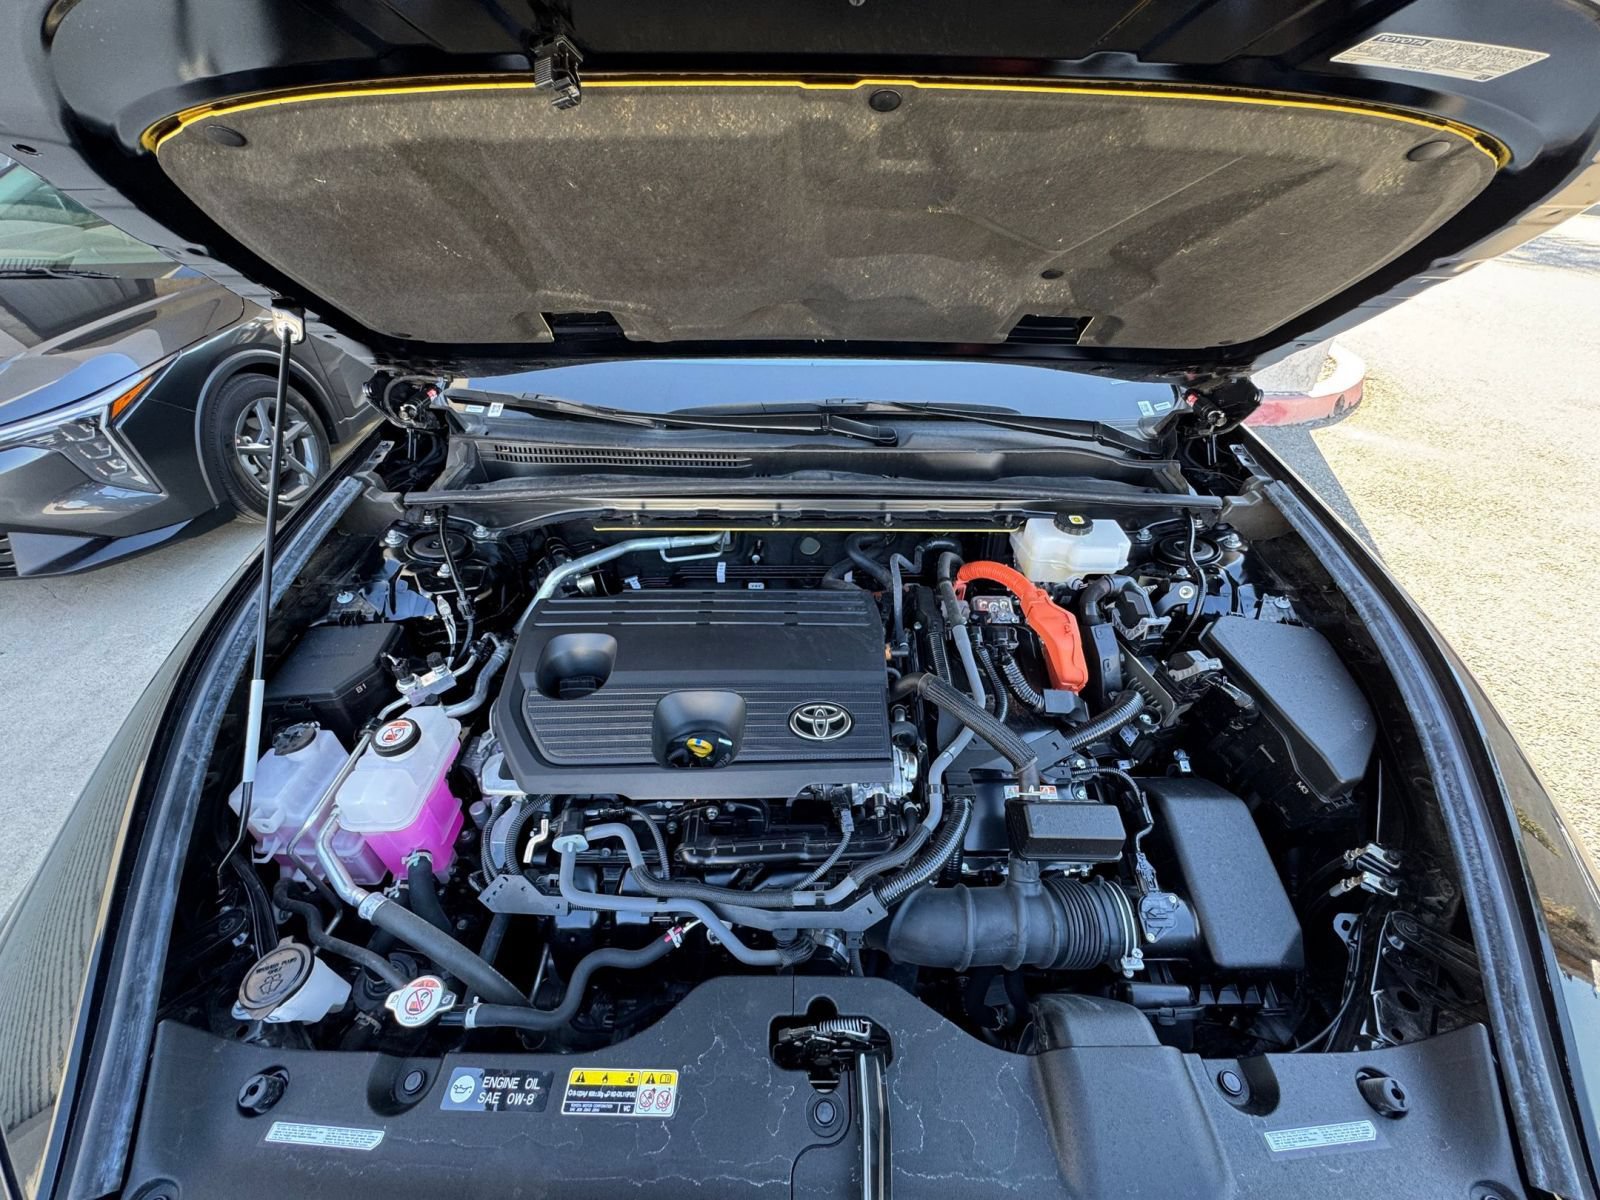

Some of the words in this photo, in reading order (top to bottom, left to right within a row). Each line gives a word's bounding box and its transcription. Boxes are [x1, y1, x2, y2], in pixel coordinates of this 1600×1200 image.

[1377, 35, 1426, 46] TOYOTA
[355, 682, 367, 694] B1
[482, 1076, 520, 1089] ENGINE
[525, 1078, 541, 1090] OIL
[477, 1092, 501, 1104] SAE
[506, 1093, 535, 1106] 0W-8
